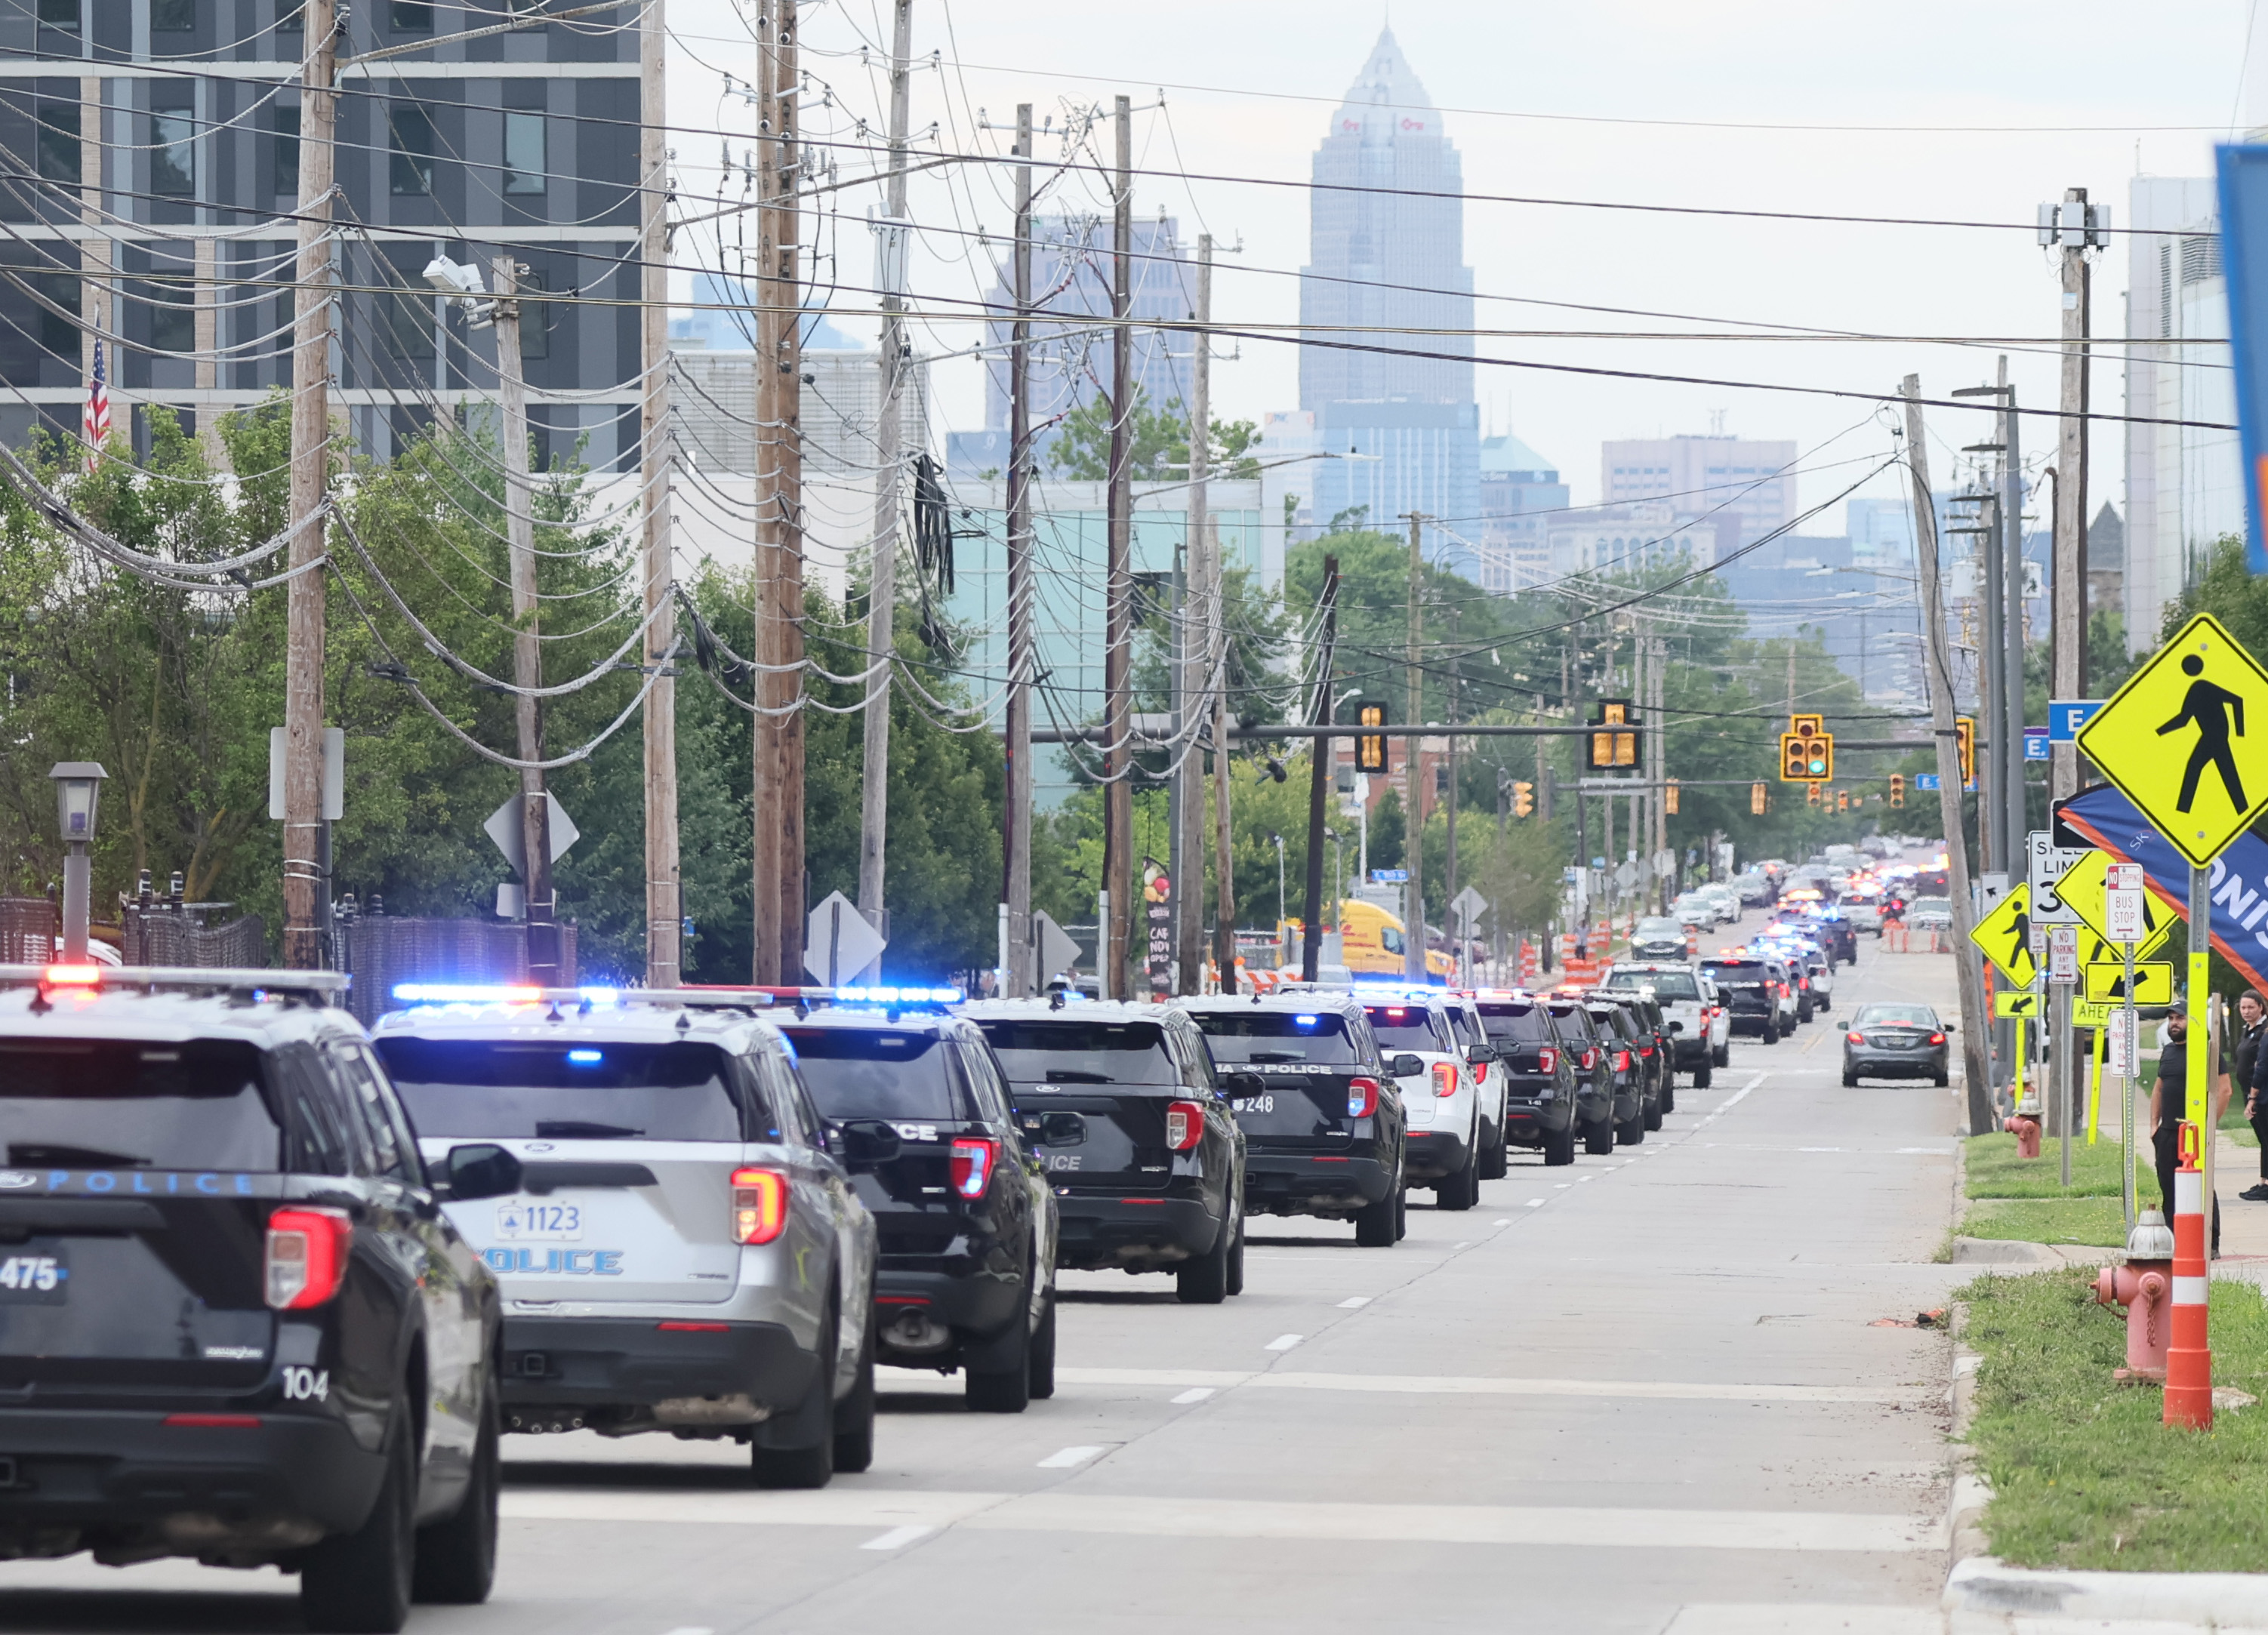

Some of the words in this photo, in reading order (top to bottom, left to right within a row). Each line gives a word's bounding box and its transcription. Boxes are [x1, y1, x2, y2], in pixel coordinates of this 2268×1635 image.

[2044, 861, 2075, 873] LIM
[2109, 872, 2118, 885] NO
[2119, 873, 2140, 882] STOPPING
[2037, 881, 2063, 913] 3
[2115, 896, 2134, 908] BUS
[2114, 912, 2135, 923] STOP
[2059, 932, 2069, 943] NO
[2053, 945, 2075, 954] PARKING
[1265, 1064, 1333, 1075] POLICE
[1246, 1096, 1274, 1113] 248
[46, 1169, 253, 1195] POLICE
[526, 1206, 580, 1231] 1123
[479, 1247, 624, 1276] OLICE
[282, 1365, 329, 1403] 104
